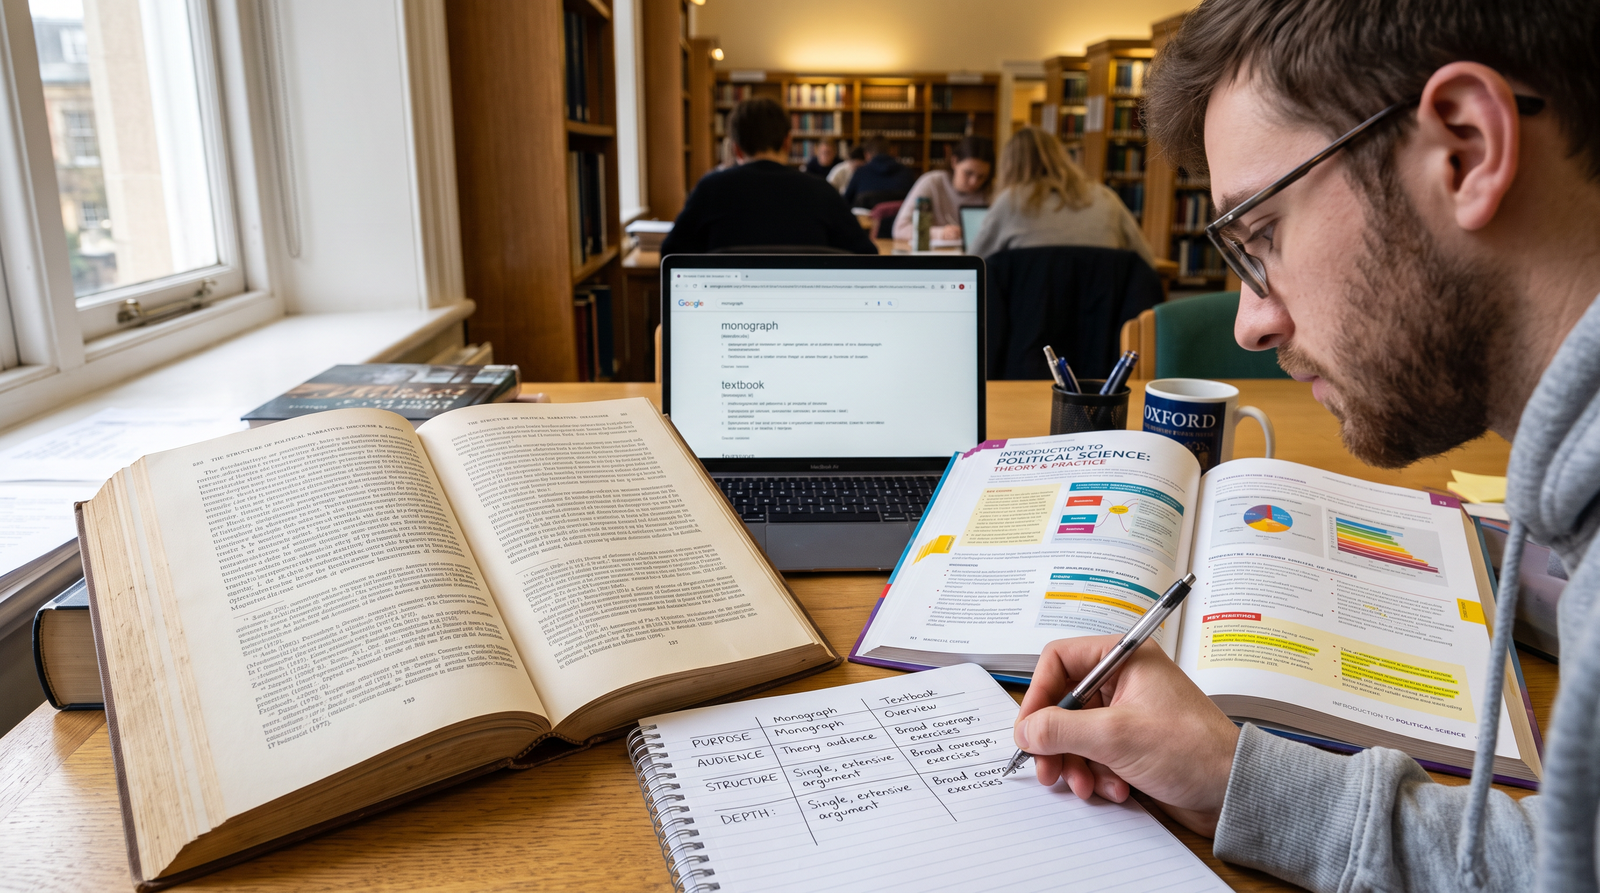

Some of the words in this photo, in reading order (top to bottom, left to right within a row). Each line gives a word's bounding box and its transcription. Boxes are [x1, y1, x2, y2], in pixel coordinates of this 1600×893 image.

[678, 299, 704, 308] Google
[722, 321, 778, 332] monograph
[721, 380, 765, 390] textbook
[1144, 404, 1216, 428] OXFORD
[996, 453, 1073, 465] POLITICAL
[1078, 450, 1151, 461] SCIENCE:
[1000, 445, 1084, 457] INTRODUCTION
[994, 464, 1037, 472] THEORY
[1051, 459, 1107, 468] PRACTICE
[879, 689, 938, 705] Textbook
[773, 707, 838, 722] Monograph
[884, 704, 937, 718] Overview
[1332, 700, 1384, 719] INTRODUCTION
[1395, 718, 1433, 731] POLITICAL
[1434, 727, 1466, 738] SCIENCE
[774, 720, 844, 736] Monograph
[895, 723, 927, 735] Broad
[932, 715, 980, 728] coverage,
[692, 732, 752, 748] PURPOSE
[910, 727, 960, 741] exercises
[780, 743, 820, 755] Theory
[827, 734, 877, 747] audience
[910, 744, 944, 758] Broad
[948, 737, 997, 750] coverage,
[926, 750, 980, 765] exercises
[793, 765, 837, 778] Single,
[842, 755, 894, 769] extensive
[706, 773, 778, 792] STRUCTURE
[802, 770, 861, 789] argument
[932, 771, 969, 785] Broad
[948, 778, 1003, 794] exercises
[808, 796, 853, 810] Single,
[857, 785, 912, 800] extensive
[819, 800, 879, 822] argument
